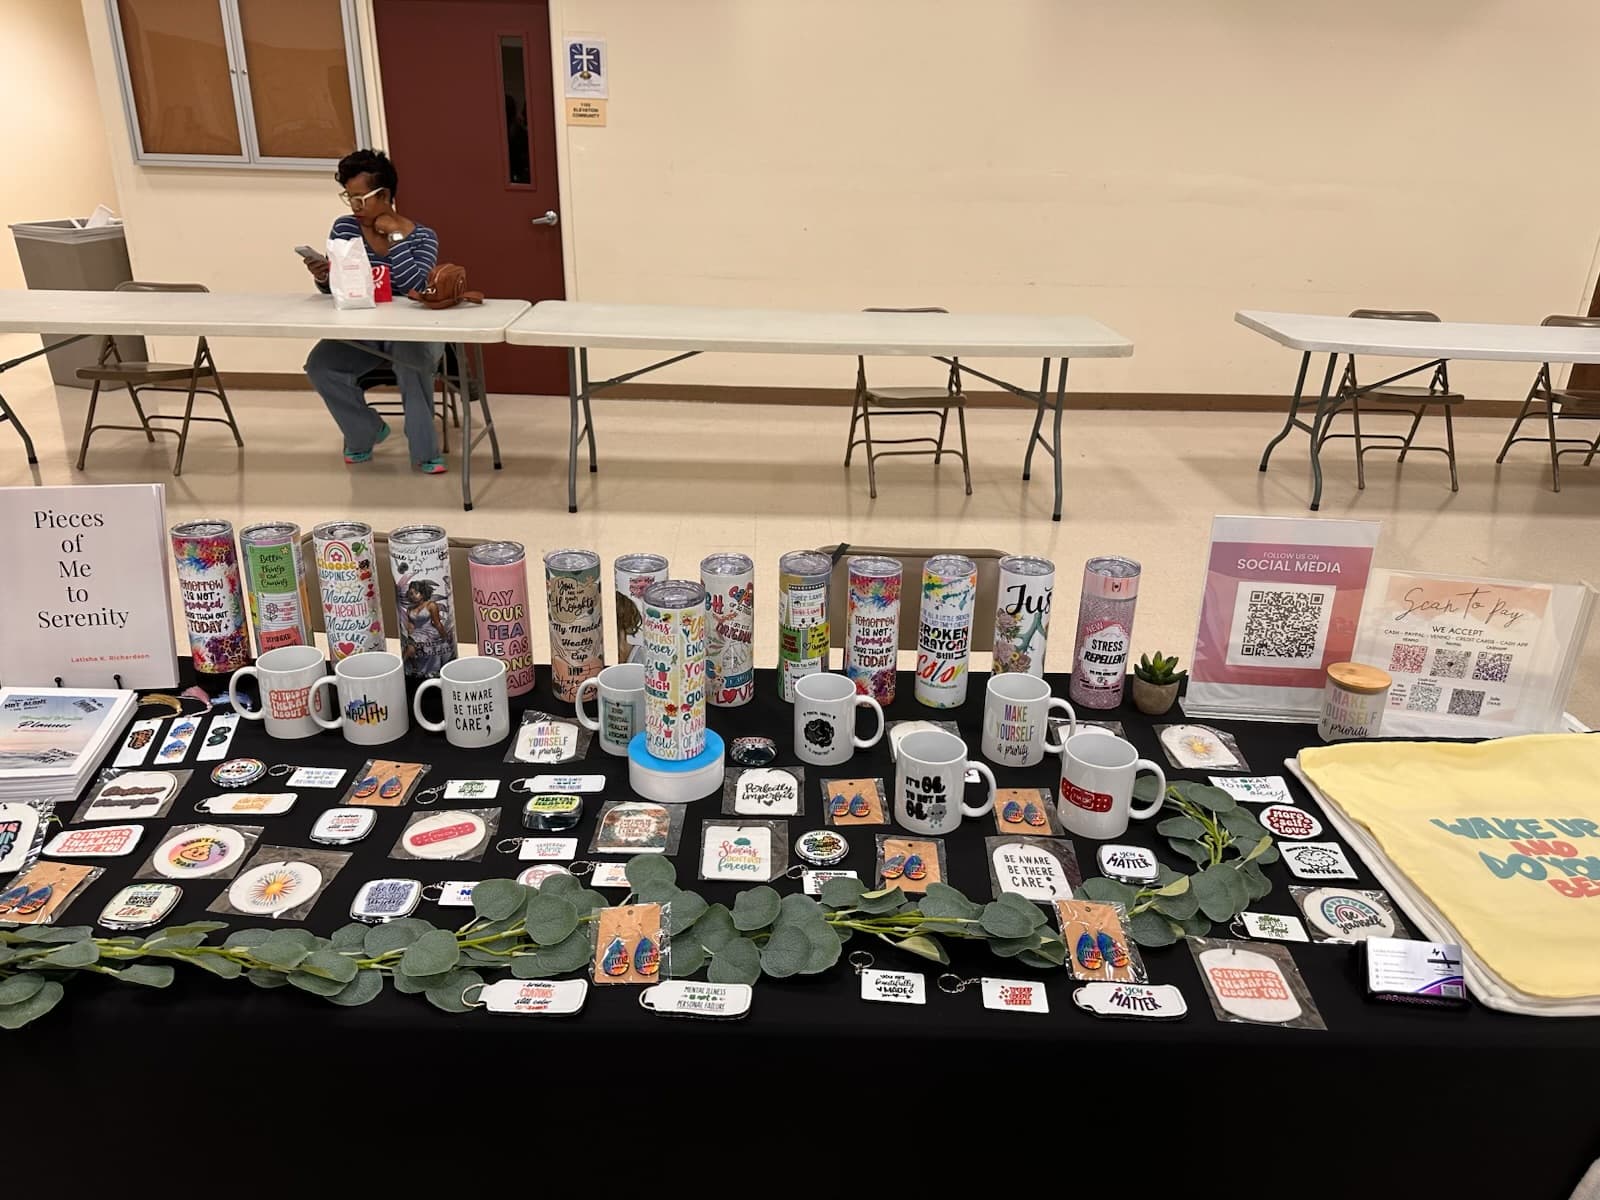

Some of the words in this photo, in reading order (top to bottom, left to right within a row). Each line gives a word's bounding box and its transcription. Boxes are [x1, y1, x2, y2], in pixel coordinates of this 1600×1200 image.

[34, 509, 104, 529] Pieces
[61, 533, 84, 553] of
[1264, 551, 1294, 560] FOLLOW
[1295, 552, 1306, 560] US
[1307, 553, 1320, 561] ON
[58, 560, 92, 578] Me
[1237, 558, 1291, 572] SOCIAL
[1294, 560, 1341, 574] MEDIA
[66, 586, 88, 603] to
[197, 591, 215, 601] NOT
[322, 587, 365, 604] Mental
[1395, 587, 1460, 621] Scan
[37, 607, 129, 629] Serenity
[214, 610, 229, 620] OUT
[479, 603, 523, 622] YOUR
[190, 620, 222, 634] TODAY
[487, 622, 524, 641] TEA
[568, 622, 601, 635] Mental
[872, 627, 889, 637] NOT
[1086, 622, 1104, 634] NEW
[1432, 626, 1446, 634] WE
[1449, 627, 1484, 637] ACCEPT
[483, 640, 505, 656] BE
[508, 637, 529, 656] AS
[561, 637, 594, 648] Health
[1091, 638, 1124, 652] STRESS
[857, 653, 889, 668] TODAY
[1083, 651, 1127, 665] REPELLENT
[451, 690, 462, 702] BE
[464, 688, 494, 703] AWARE
[1332, 688, 1368, 710] MAKE
[453, 704, 464, 716] BE
[466, 701, 495, 717] THERE
[1004, 703, 1028, 722] MAKE
[1325, 702, 1378, 725] OURSELF
[537, 726, 561, 736] MAKE
[996, 721, 1035, 742] YOURSELF
[528, 736, 569, 748] YOURSELF
[538, 748, 564, 760] priority
[1003, 744, 1030, 765] priority
[744, 782, 792, 793] Perfectly
[1272, 809, 1305, 821] more
[1279, 818, 1305, 827] self
[1429, 817, 1558, 840] WAKE
[1280, 826, 1310, 836] love
[1509, 839, 1579, 858] AND
[1004, 854, 1016, 864] BE
[1019, 854, 1051, 865] AWARE
[1106, 855, 1153, 869] MATTER
[1478, 850, 1548, 881] DO
[1007, 864, 1020, 875] BE
[1023, 865, 1055, 877] THERE
[1300, 867, 1345, 875] MATTERS
[1547, 876, 1600, 899] BE
[1341, 909, 1359, 921] be
[1336, 914, 1386, 935] yourself
[685, 986, 705, 994] MENTAL
[705, 987, 726, 996] ILLNESS
[883, 986, 908, 994] MADE
[1222, 987, 1259, 998] ABOUT
[1262, 988, 1286, 999] YOU
[697, 994, 711, 1002] not
[1109, 991, 1163, 1012] MATTER
[676, 999, 703, 1009] PERSONAL
[704, 1002, 726, 1012] FAILURE
